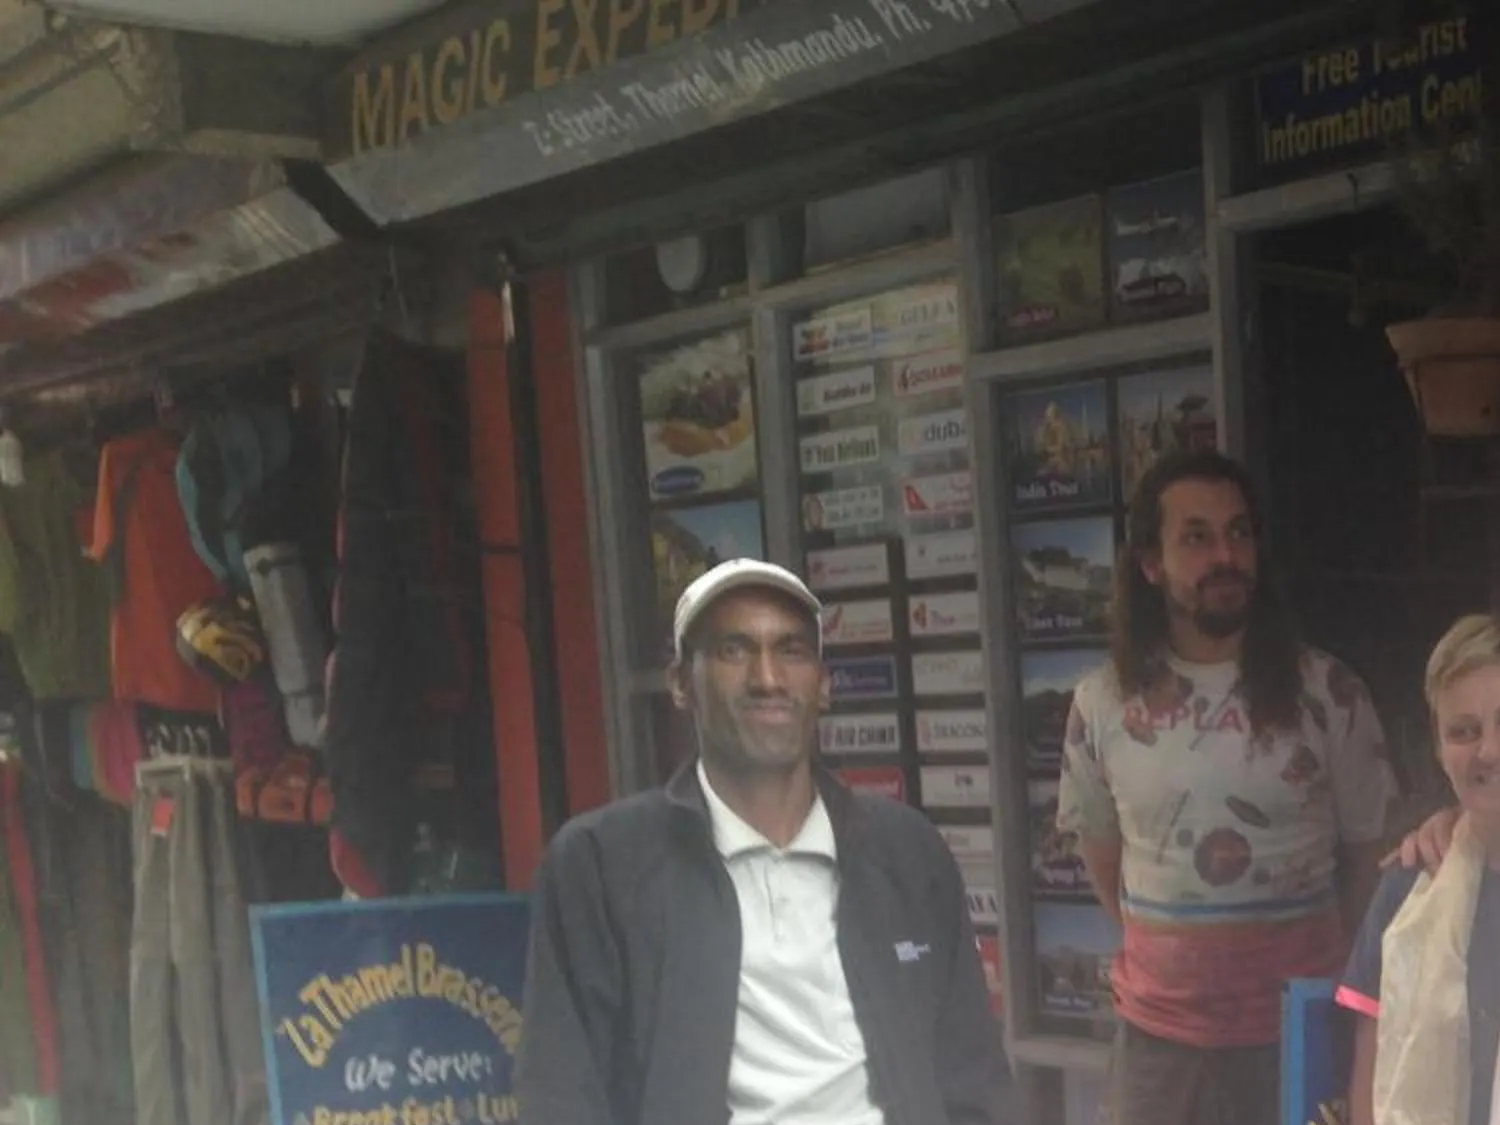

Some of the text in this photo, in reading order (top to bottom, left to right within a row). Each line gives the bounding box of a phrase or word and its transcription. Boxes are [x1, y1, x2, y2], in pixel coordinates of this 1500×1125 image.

[352, 18, 512, 156] MAGIC
[1301, 48, 1360, 96] Free
[1261, 89, 1413, 164] Information
[344, 1053, 396, 1094] We
